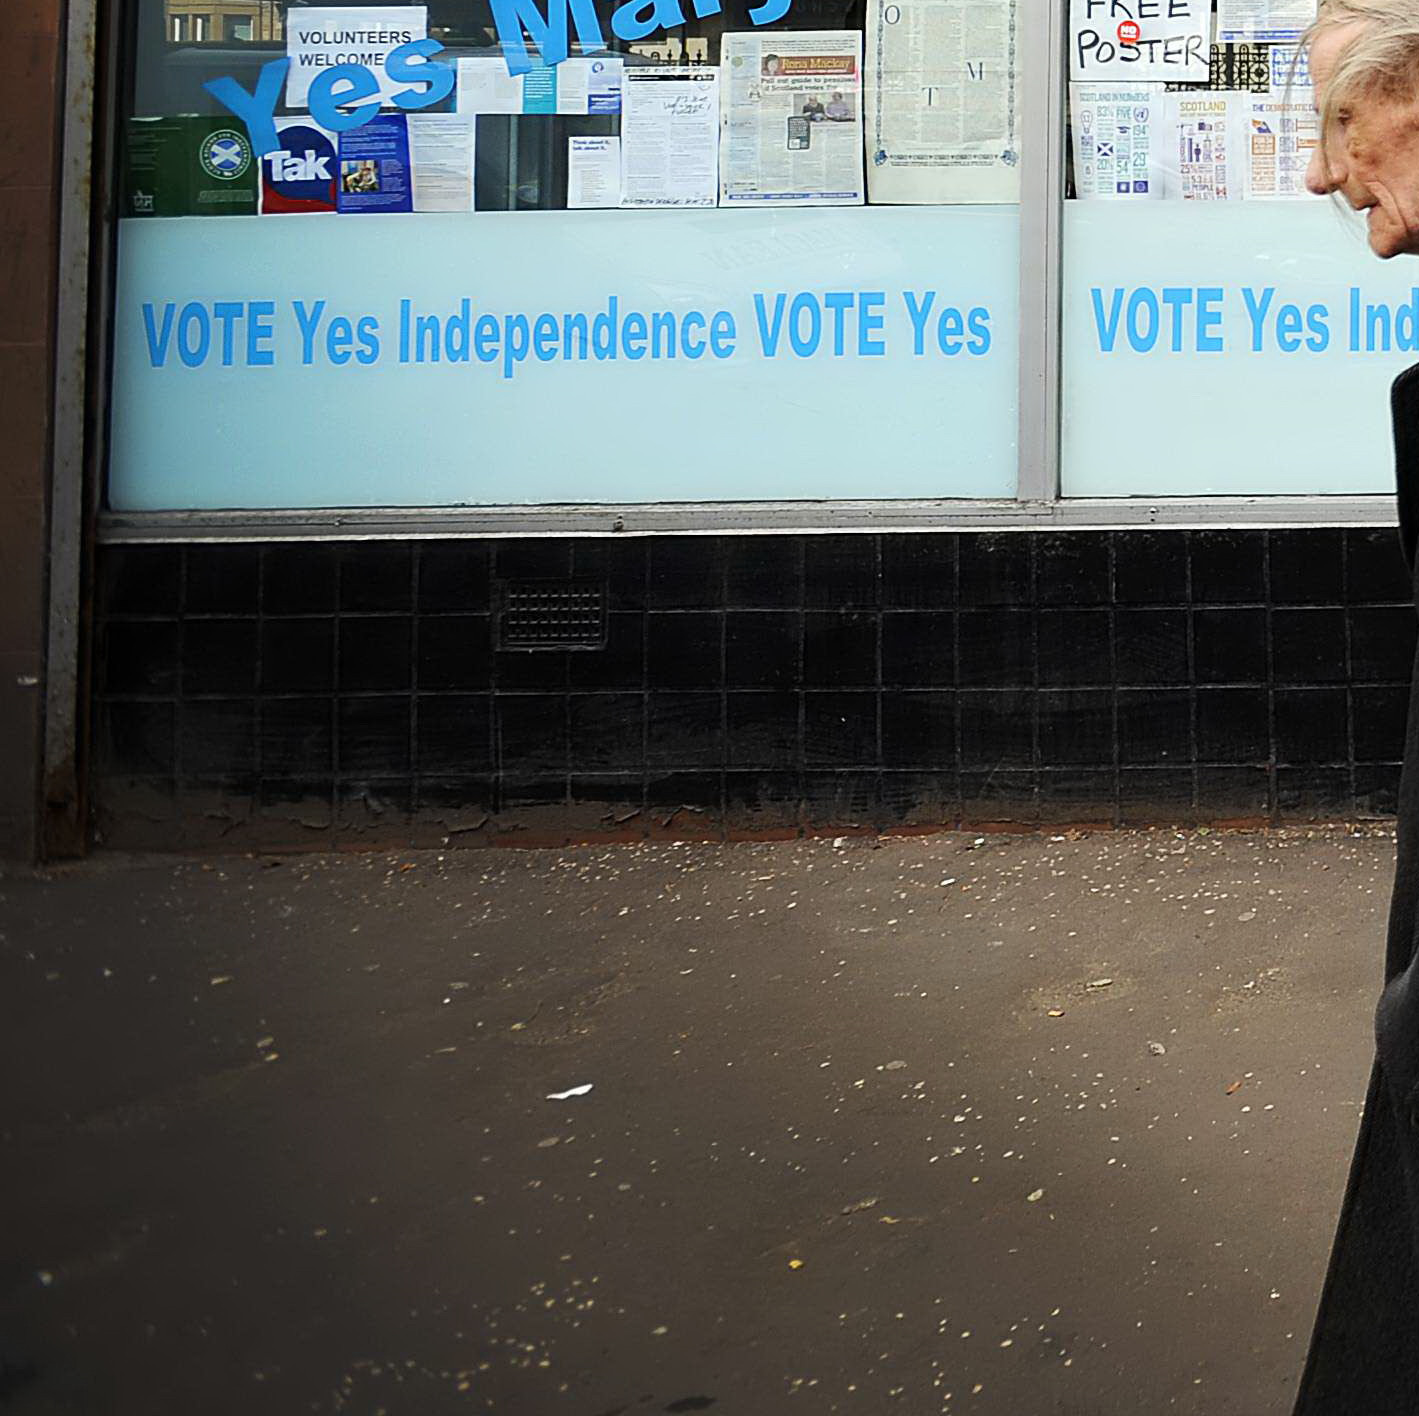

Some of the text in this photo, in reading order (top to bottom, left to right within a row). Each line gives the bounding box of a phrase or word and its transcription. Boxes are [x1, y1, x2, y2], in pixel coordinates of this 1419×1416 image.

[885, 5, 901, 25] O
[299, 30, 412, 45] VOLUNTEERS
[1077, 29, 1211, 69] POSTER
[299, 53, 385, 67] WELCOME
[967, 62, 984, 81] M
[201, 38, 456, 158] Yes
[922, 87, 939, 106] T
[1092, 287, 1225, 353] VOTE
[1242, 286, 1330, 353] Yes
[142, 290, 992, 379] VOTE Yes Independence VOTE Yes
